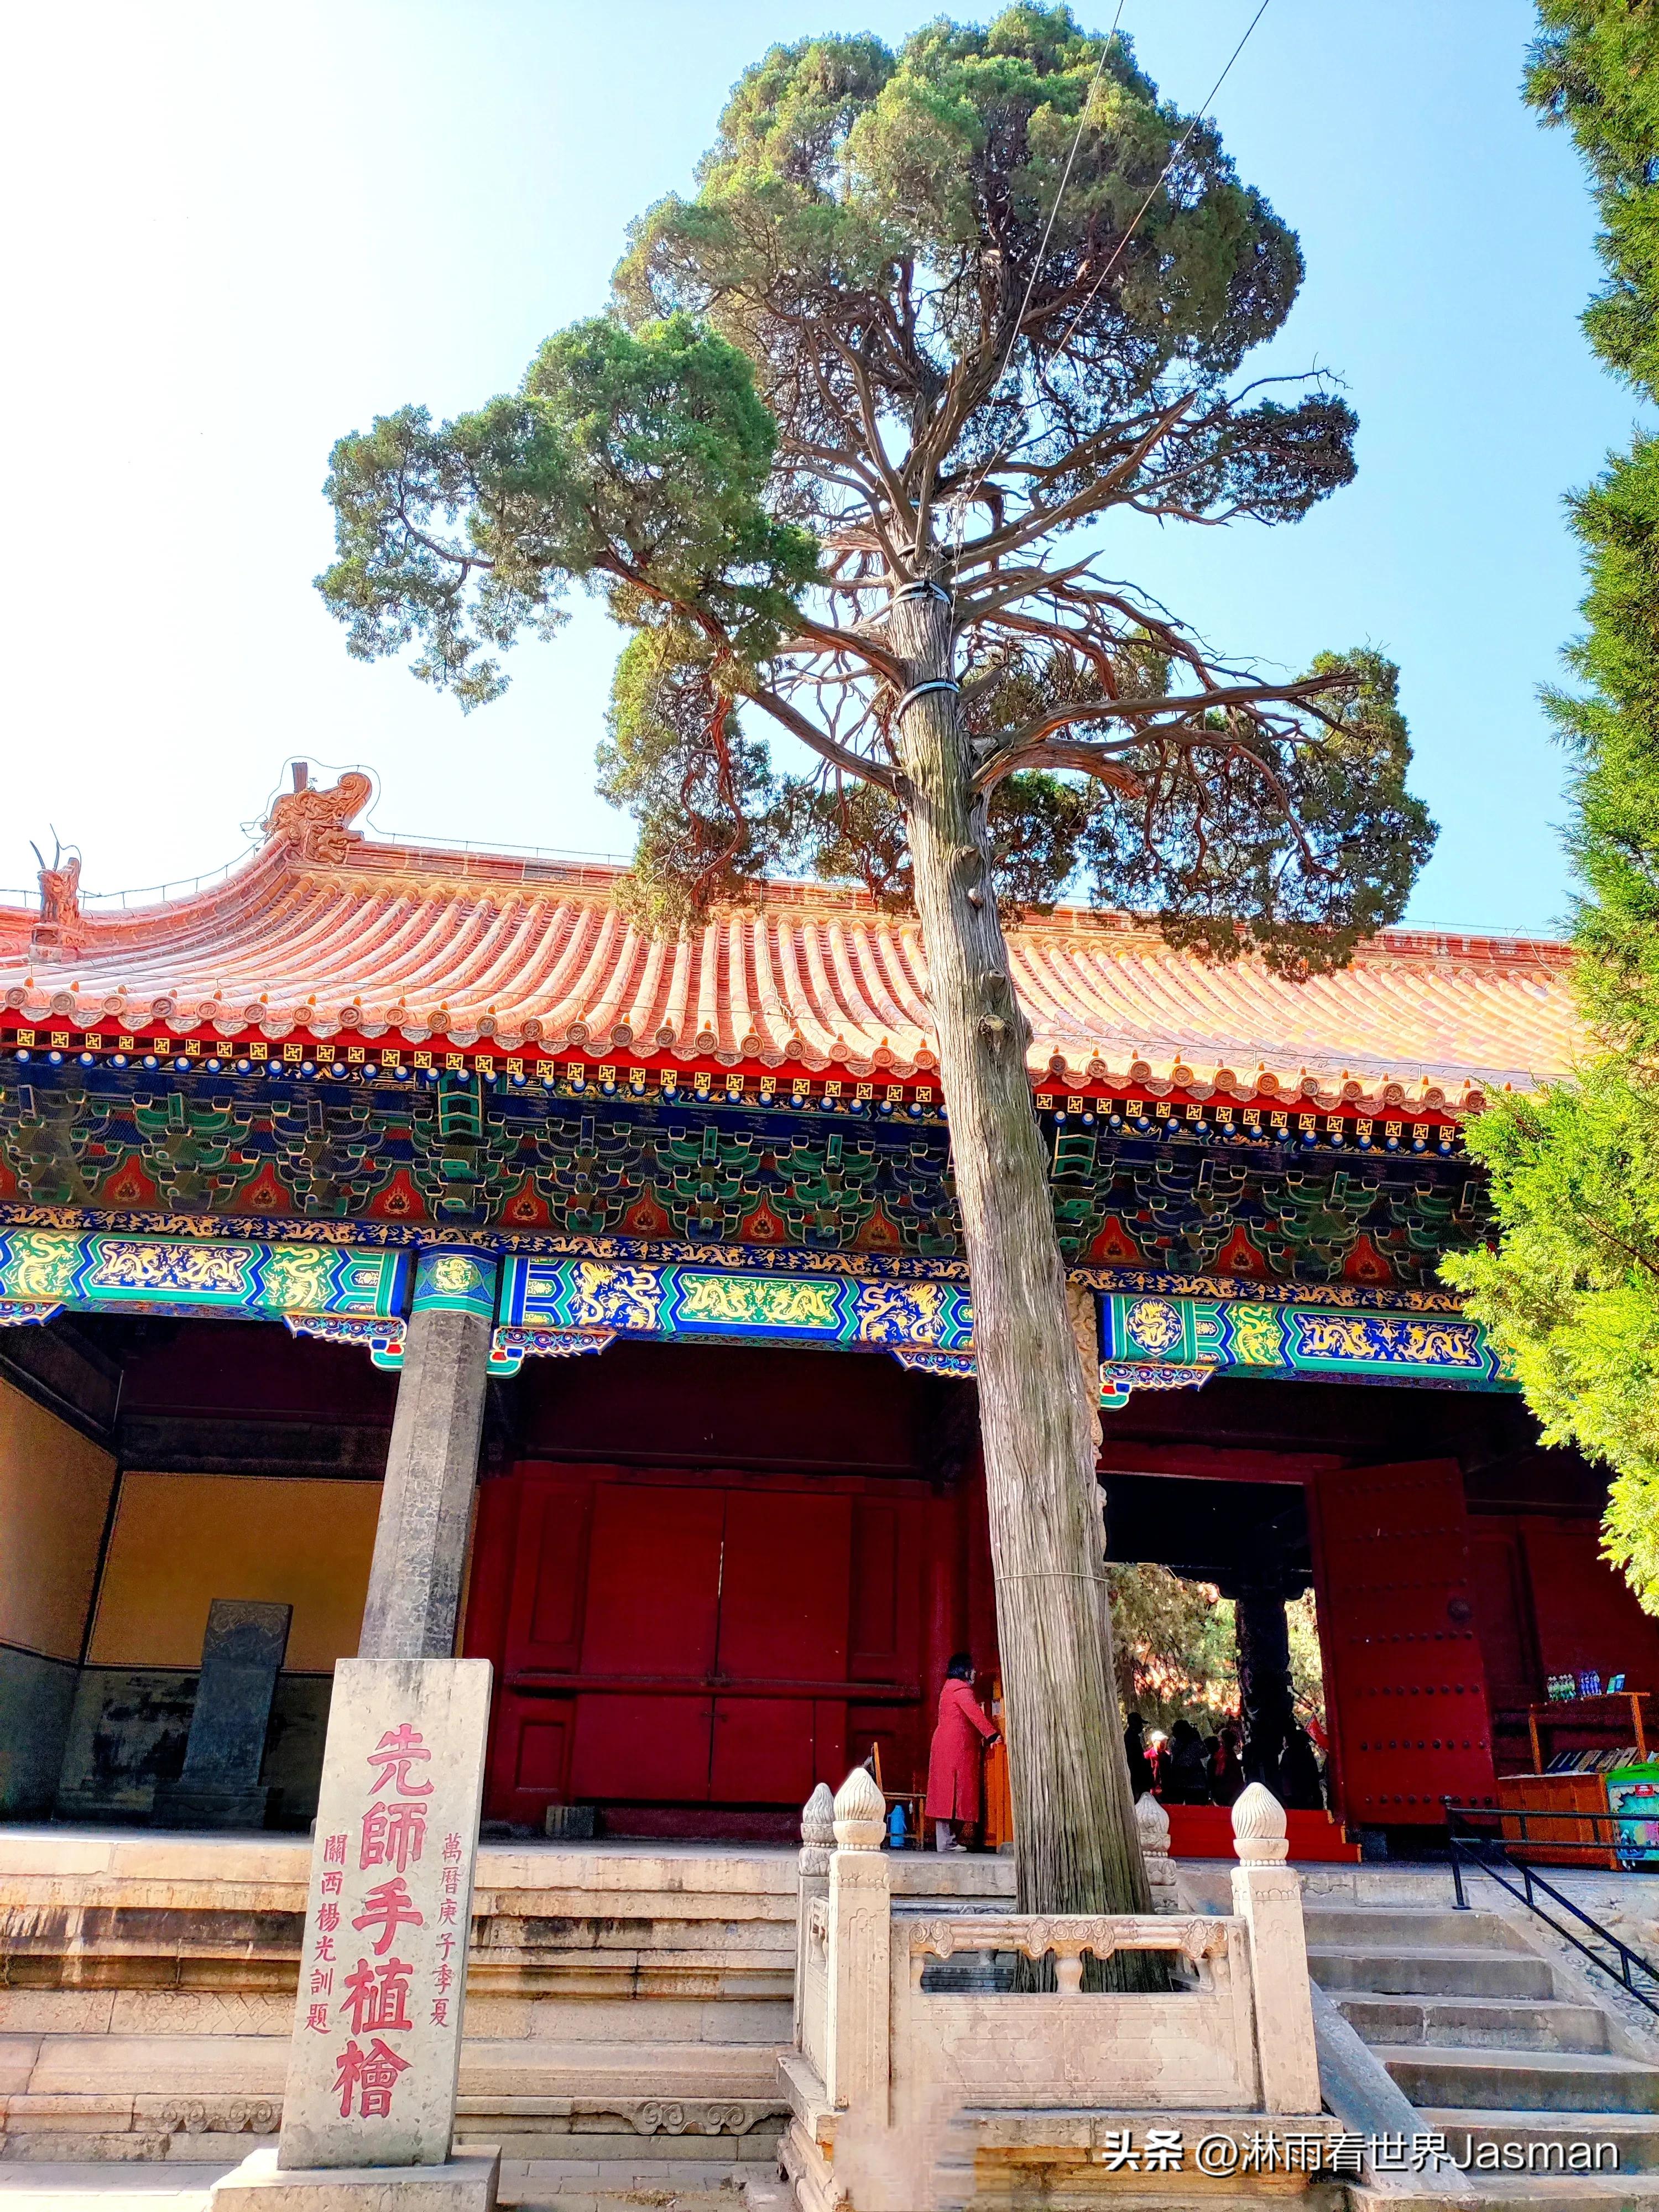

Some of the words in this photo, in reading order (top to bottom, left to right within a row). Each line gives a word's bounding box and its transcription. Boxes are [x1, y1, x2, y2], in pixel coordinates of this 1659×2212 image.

[331, 1723, 435, 2119] 先師手植檜
